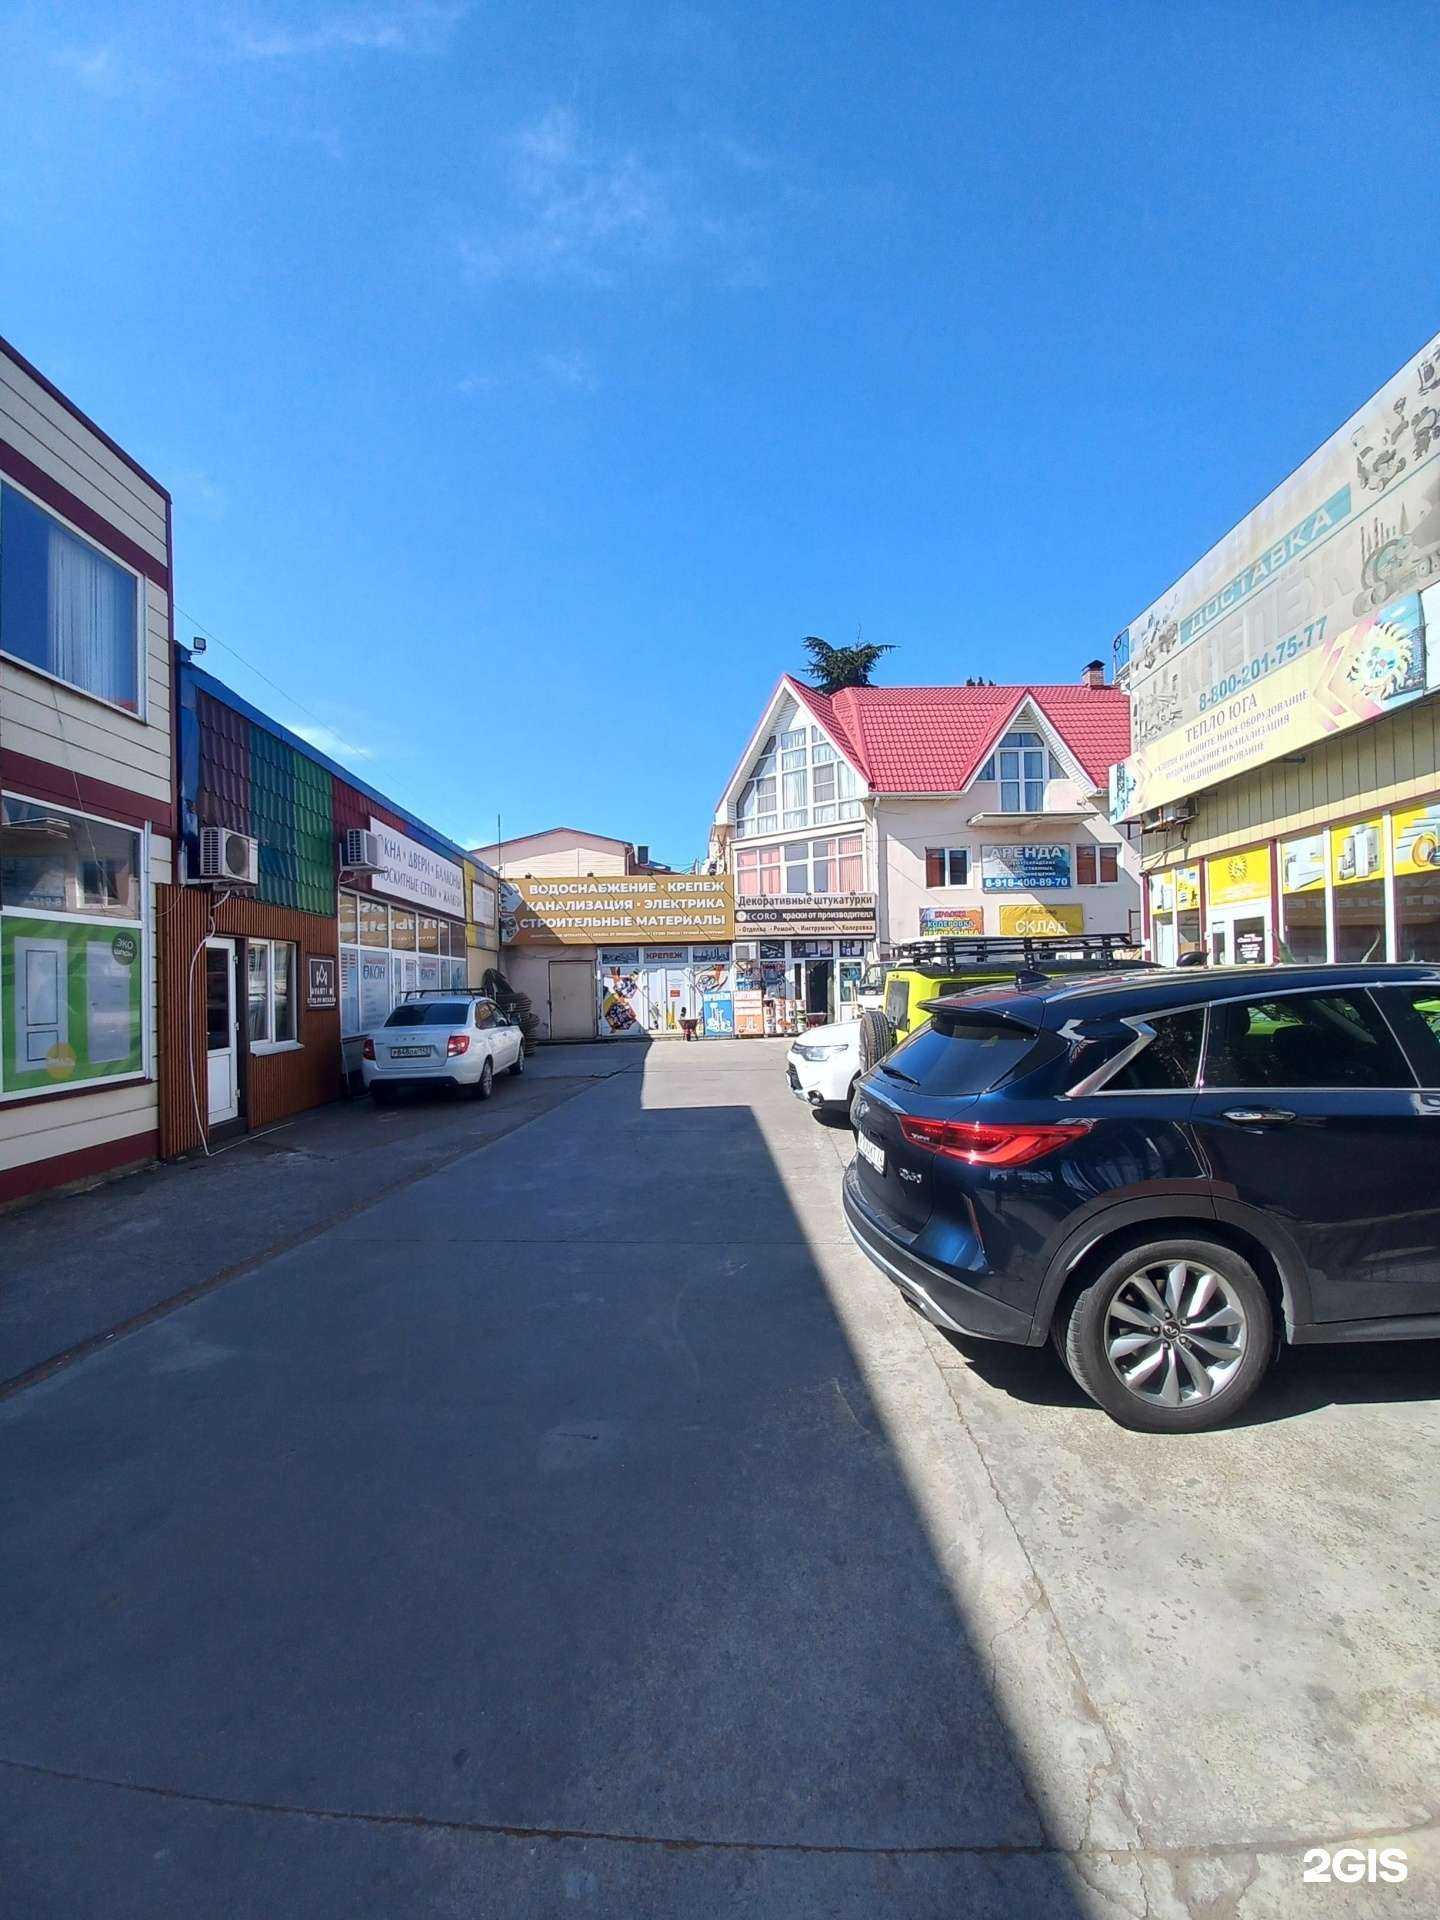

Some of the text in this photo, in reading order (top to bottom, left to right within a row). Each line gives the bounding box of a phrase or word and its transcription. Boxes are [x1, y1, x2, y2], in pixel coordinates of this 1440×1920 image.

[1190, 507, 1332, 635] ДОСТАВКА
[1199, 615, 1328, 712] 8-800-201-75-77
[1241, 688, 1309, 728] ОБОРУДОВАНИЕ
[1184, 693, 1258, 743] ТЕПЛО ЮГА
[1229, 714, 1290, 751] КАНАЛИЗАЦИЯ
[990, 847, 1062, 859] АРЕНДА
[529, 881, 725, 895] ВОДОСНАБЖЕНИЕ КРЕПЕЖ
[985, 878, 1068, 887] 8-918-400-89-70
[526, 898, 725, 912] КАНАЛИЗАЦИЯ ЭЛЕКТРИКА
[738, 895, 872, 908] Декоративные штукатурки
[519, 914, 726, 928] СТРОИТЕЛЬНЫЕ МАТЕРИАЛЫ
[782, 911, 807, 920] краски
[817, 910, 874, 920] производителя
[1015, 920, 1070, 934] СКЛАД
[117, 938, 134, 950] ЭКО
[646, 951, 683, 959] КРЕПЕЖ
